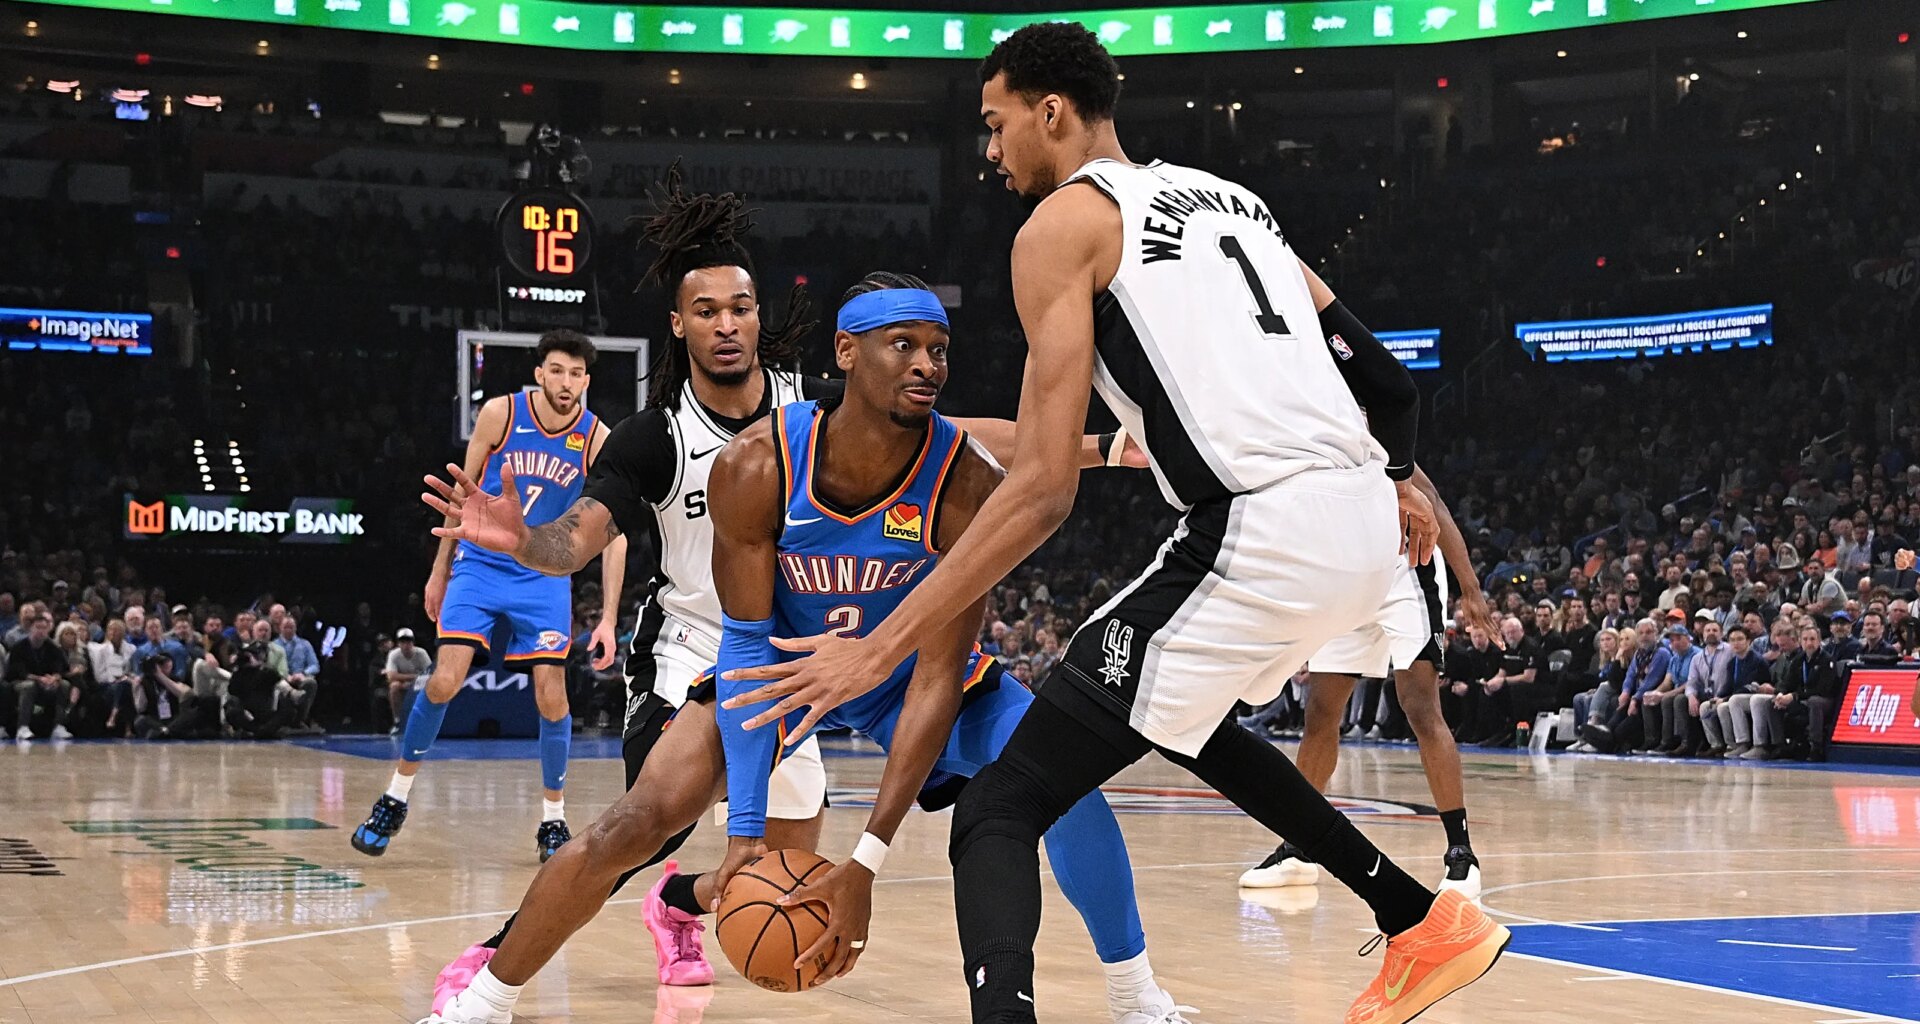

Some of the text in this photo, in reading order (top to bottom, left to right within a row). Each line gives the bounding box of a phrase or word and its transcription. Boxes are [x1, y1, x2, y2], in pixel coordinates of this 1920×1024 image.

[523, 205, 578, 233] 10:17
[536, 230, 574, 274] 16
[1216, 233, 1294, 337] 1
[41, 316, 139, 341] ImageNet
[1524, 332, 1554, 342] OFFICE
[1554, 330, 1580, 341] PRINT
[1581, 327, 1628, 339] SOLUTIONS
[1633, 323, 1676, 336] DOCUMENT
[1683, 319, 1717, 332] PROCESS
[1717, 313, 1767, 328] AUTOMATION
[1541, 341, 1580, 353] MANAGED
[1581, 340, 1591, 351] IT
[1668, 332, 1704, 345] PRINTERS
[1712, 326, 1752, 341] SCANNERS
[504, 451, 580, 488] THUNDER
[522, 484, 544, 517] 7
[824, 603, 864, 640] 2
[1862, 685, 1901, 734] App
